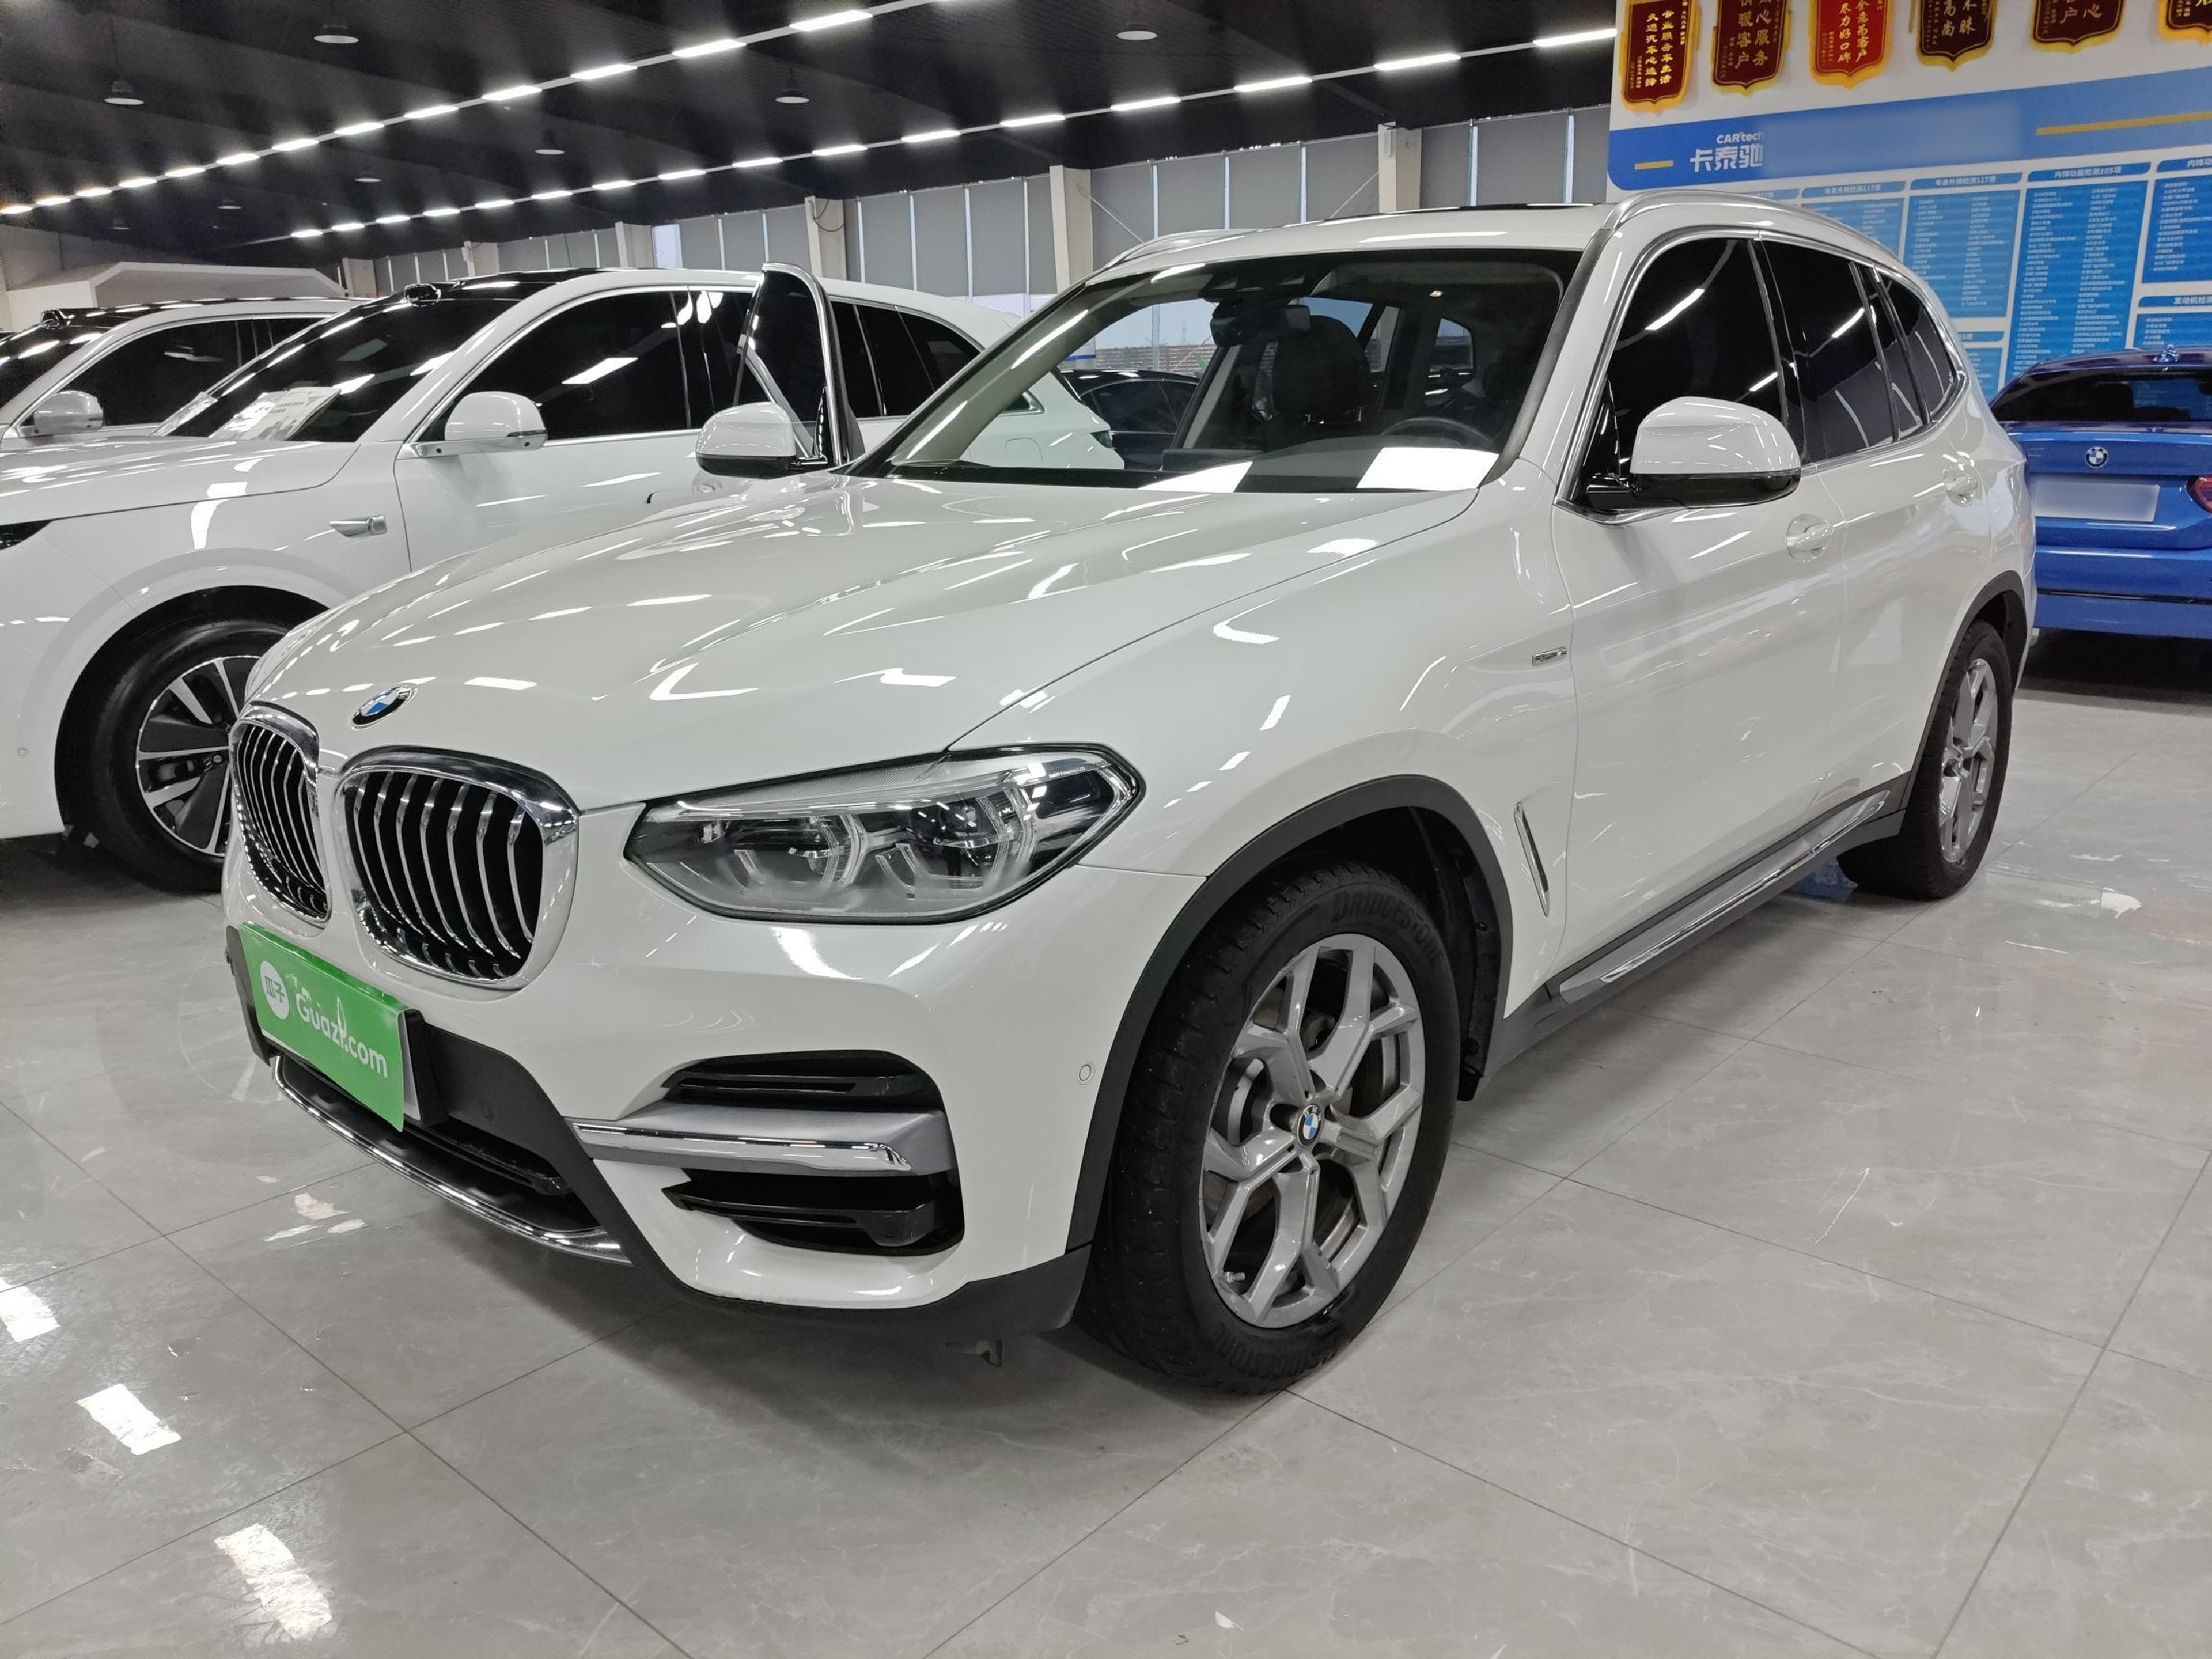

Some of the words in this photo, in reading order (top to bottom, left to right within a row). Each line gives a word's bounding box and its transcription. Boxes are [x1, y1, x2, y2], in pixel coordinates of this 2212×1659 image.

[1752, 0, 1772, 67] 心服务
[1690, 143, 1763, 173] 卡泰驰
[264, 976, 285, 1003] 瓜子
